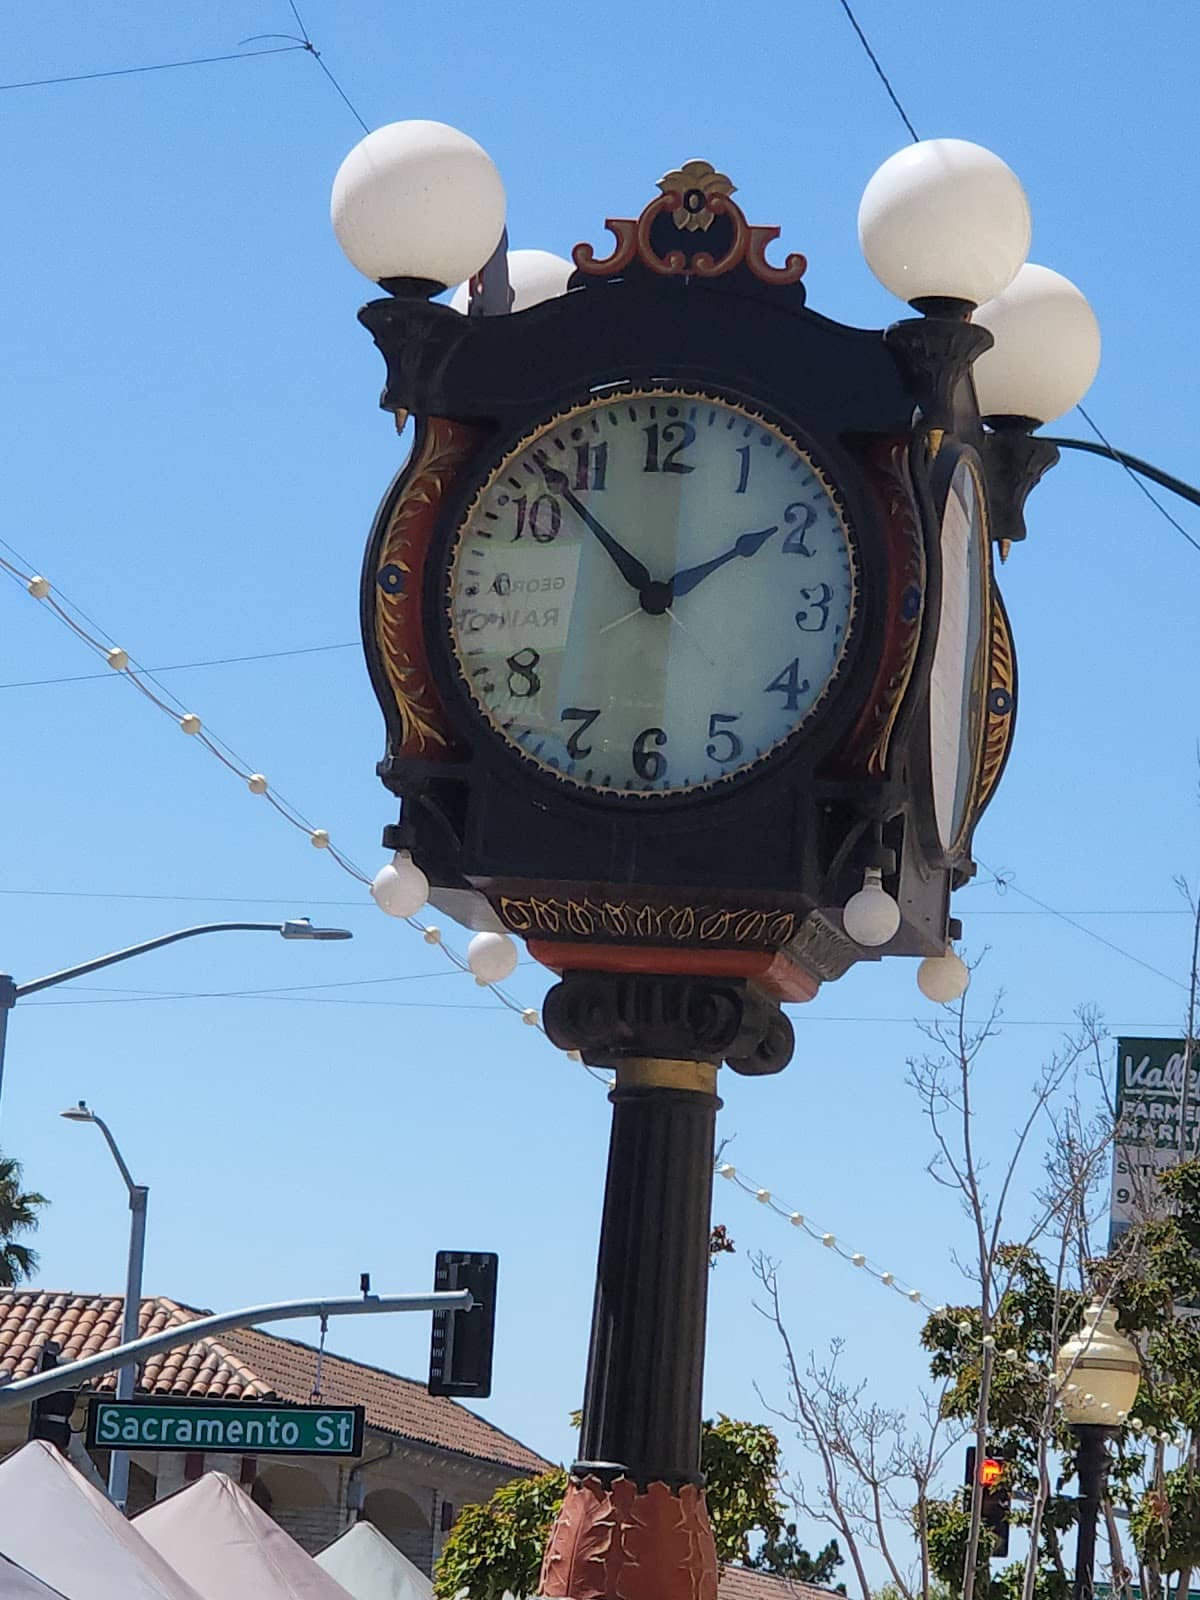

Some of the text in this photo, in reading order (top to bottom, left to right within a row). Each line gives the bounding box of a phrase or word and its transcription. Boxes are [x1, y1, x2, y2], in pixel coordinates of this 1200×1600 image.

[573, 441, 608, 491] 11
[644, 420, 696, 474] 12
[735, 444, 751, 493] 1
[510, 494, 561, 543] 10
[782, 502, 817, 558] 2
[795, 583, 833, 632] 3
[506, 647, 541, 697] 8
[764, 657, 809, 711] 4
[561, 708, 600, 760] 7
[632, 727, 668, 781] 6
[706, 713, 741, 763] 5
[1125, 1053, 1200, 1089] Valle
[100, 1410, 350, 1447] Sacramento St
